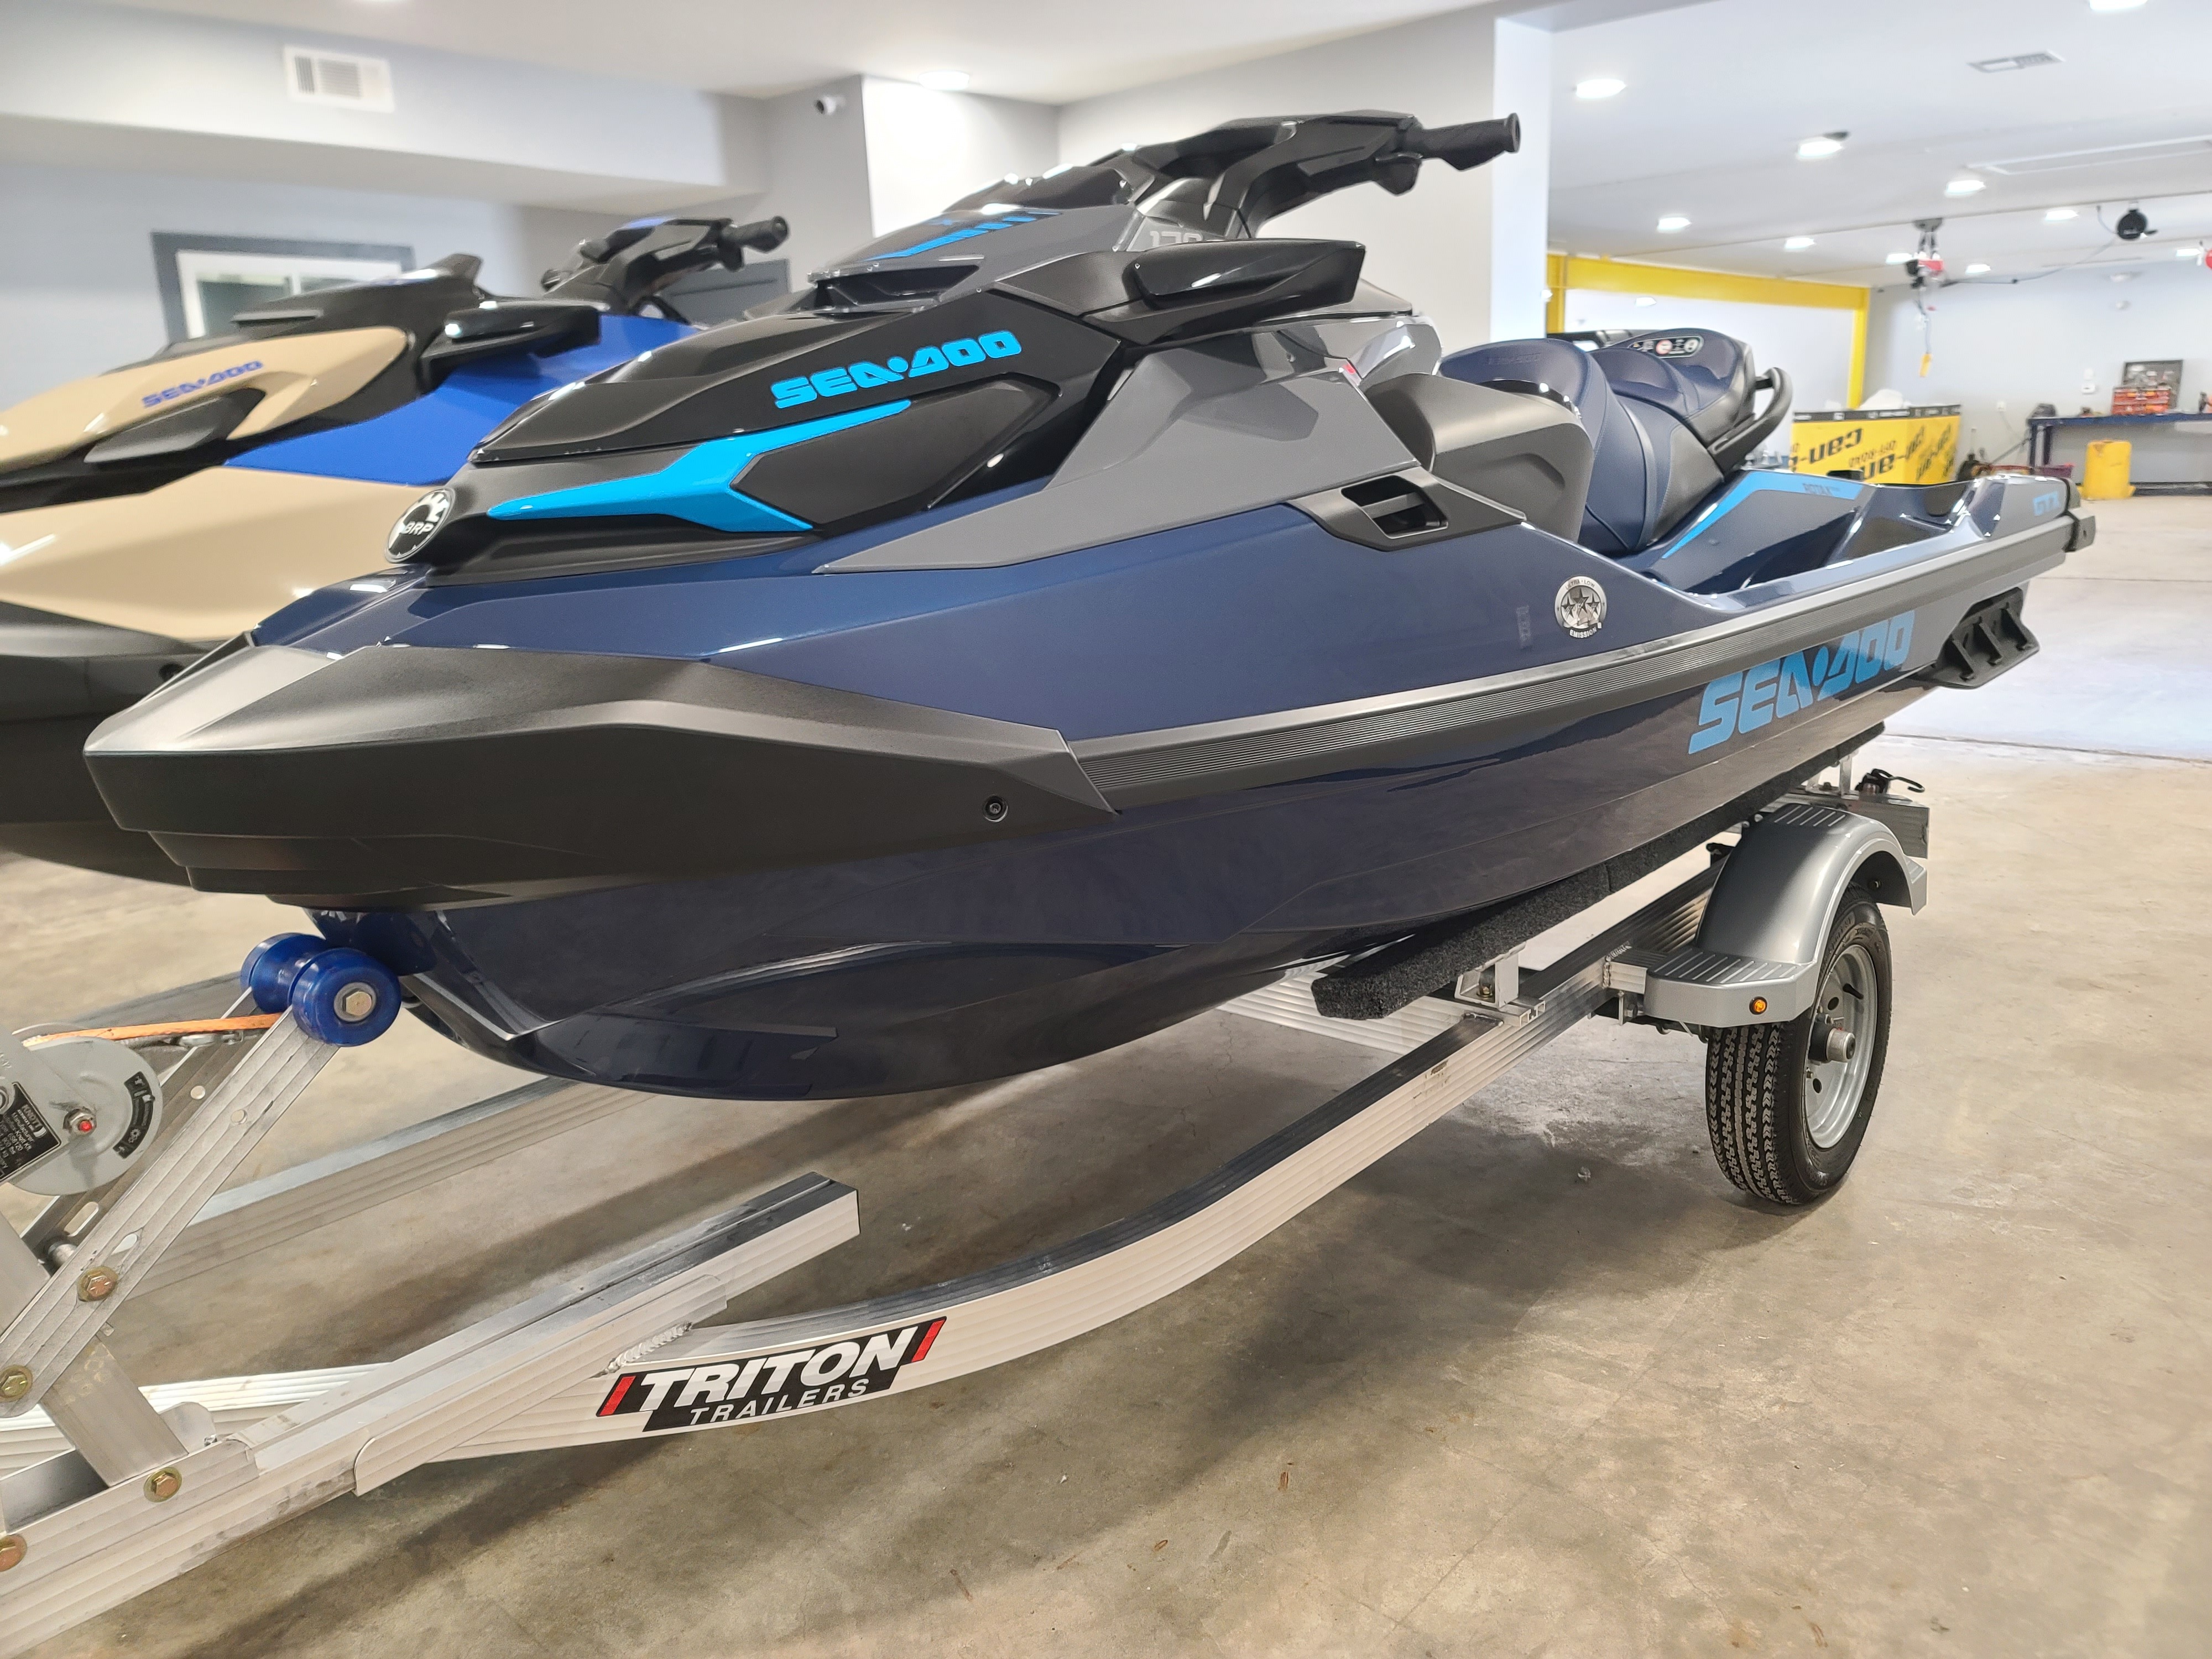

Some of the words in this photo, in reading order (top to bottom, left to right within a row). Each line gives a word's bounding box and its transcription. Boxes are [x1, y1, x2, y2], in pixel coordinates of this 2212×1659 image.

[401, 520, 435, 535] BRP
[1565, 578, 1580, 590] ULTRA
[1584, 579, 1595, 588] LOW
[1569, 626, 1597, 638] EMISSION
[21, 1104, 42, 1129] KNOTT
[640, 1326, 919, 1412] TRITON
[690, 1378, 870, 1425] TRAILERS
